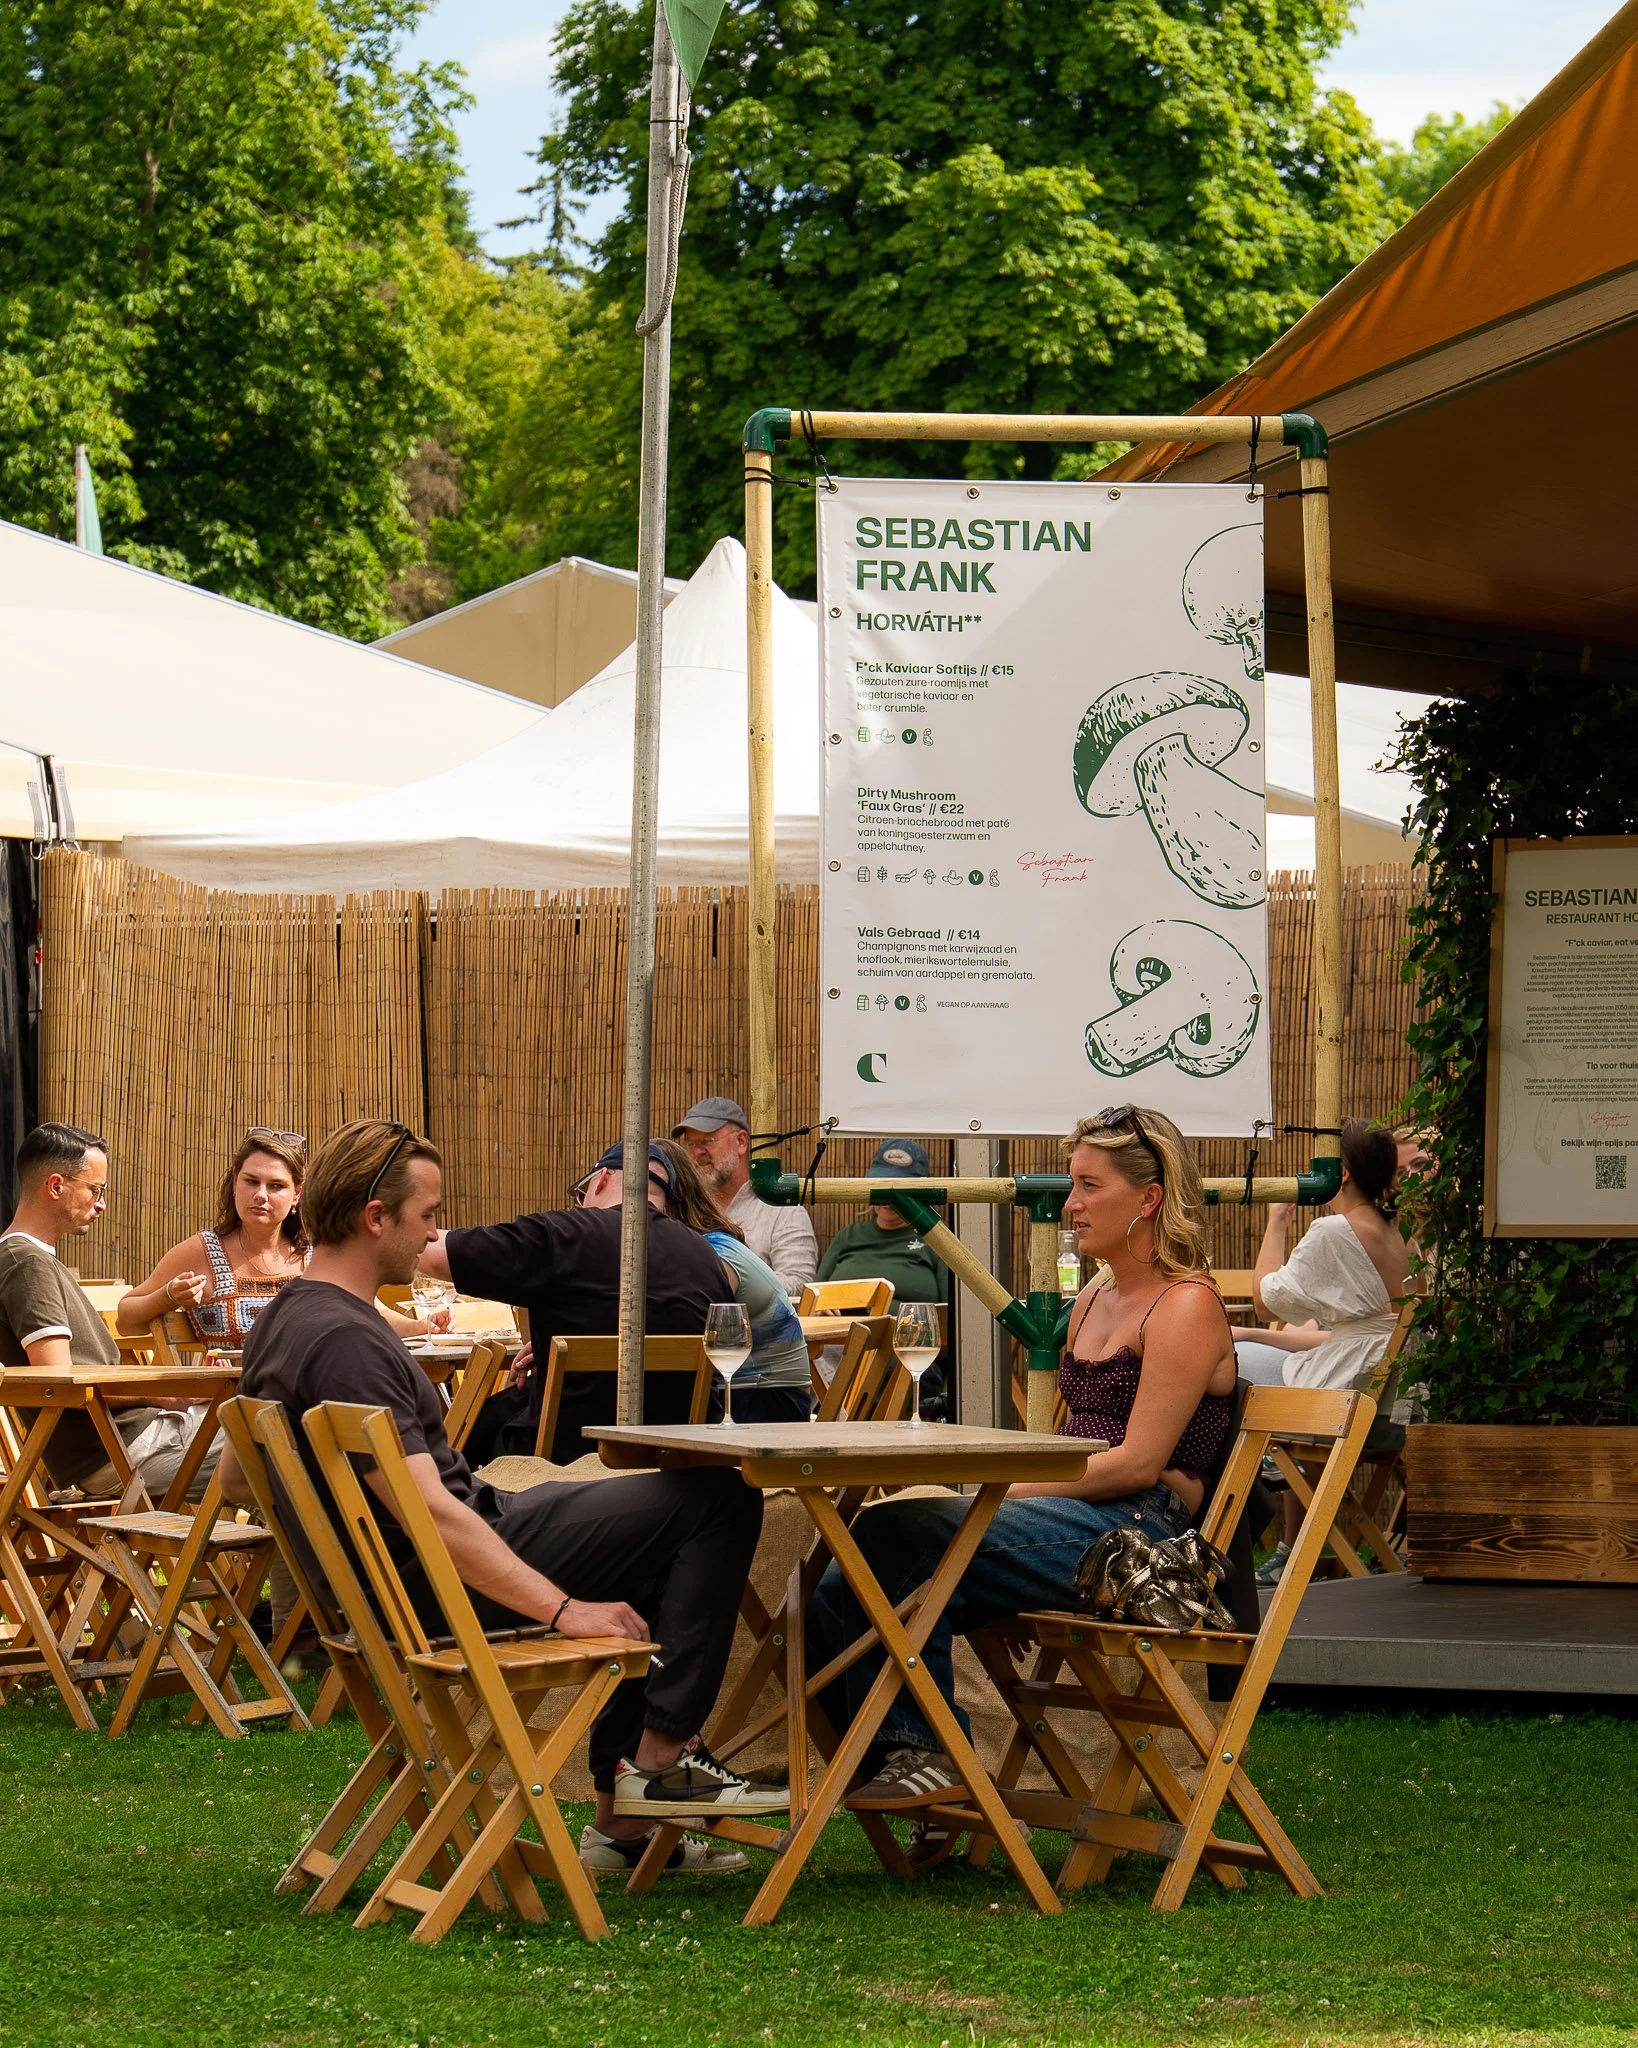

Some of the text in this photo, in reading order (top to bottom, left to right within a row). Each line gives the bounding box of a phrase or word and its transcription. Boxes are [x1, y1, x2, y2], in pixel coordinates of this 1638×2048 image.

[856, 517, 1092, 552] SEBASTIAN
[856, 560, 997, 593] FRANK
[886, 663, 933, 674] Kaviaar
[936, 664, 977, 676] Softijs
[992, 665, 1014, 675] €15
[857, 677, 988, 689] Gezouten zure-roomijs met
[857, 690, 921, 700] vegetarische
[923, 691, 959, 700] kaviaar
[857, 702, 927, 712] boter crumble.
[858, 788, 956, 801] Dirty Mushroom
[940, 804, 964, 814] €22
[858, 814, 1010, 828] Citroen-briochebrood met paté
[858, 829, 876, 837] van
[878, 829, 975, 841] koningsoesterzwam
[858, 842, 925, 853] appelchutney.
[1017, 852, 1094, 871] Sebastian
[1042, 868, 1088, 888] Frank
[1525, 888, 1637, 907] SEBASTIAN
[1546, 913, 1621, 924] RESTAURANT
[858, 927, 884, 938] Vals
[887, 928, 941, 939] Gebraad
[958, 930, 980, 940] €14
[857, 942, 926, 952] Champignons
[949, 944, 1002, 955] karwijzaad
[857, 955, 1010, 967] knoflook, mierikswortelemulsie,
[857, 968, 893, 977] schuim
[916, 970, 966, 980] aardappel
[982, 972, 1035, 981] gremolata.
[1586, 1062, 1598, 1070] Tip
[1561, 1139, 1584, 1148] Bekijk
[1587, 1139, 1623, 1148] wijn-spijs
